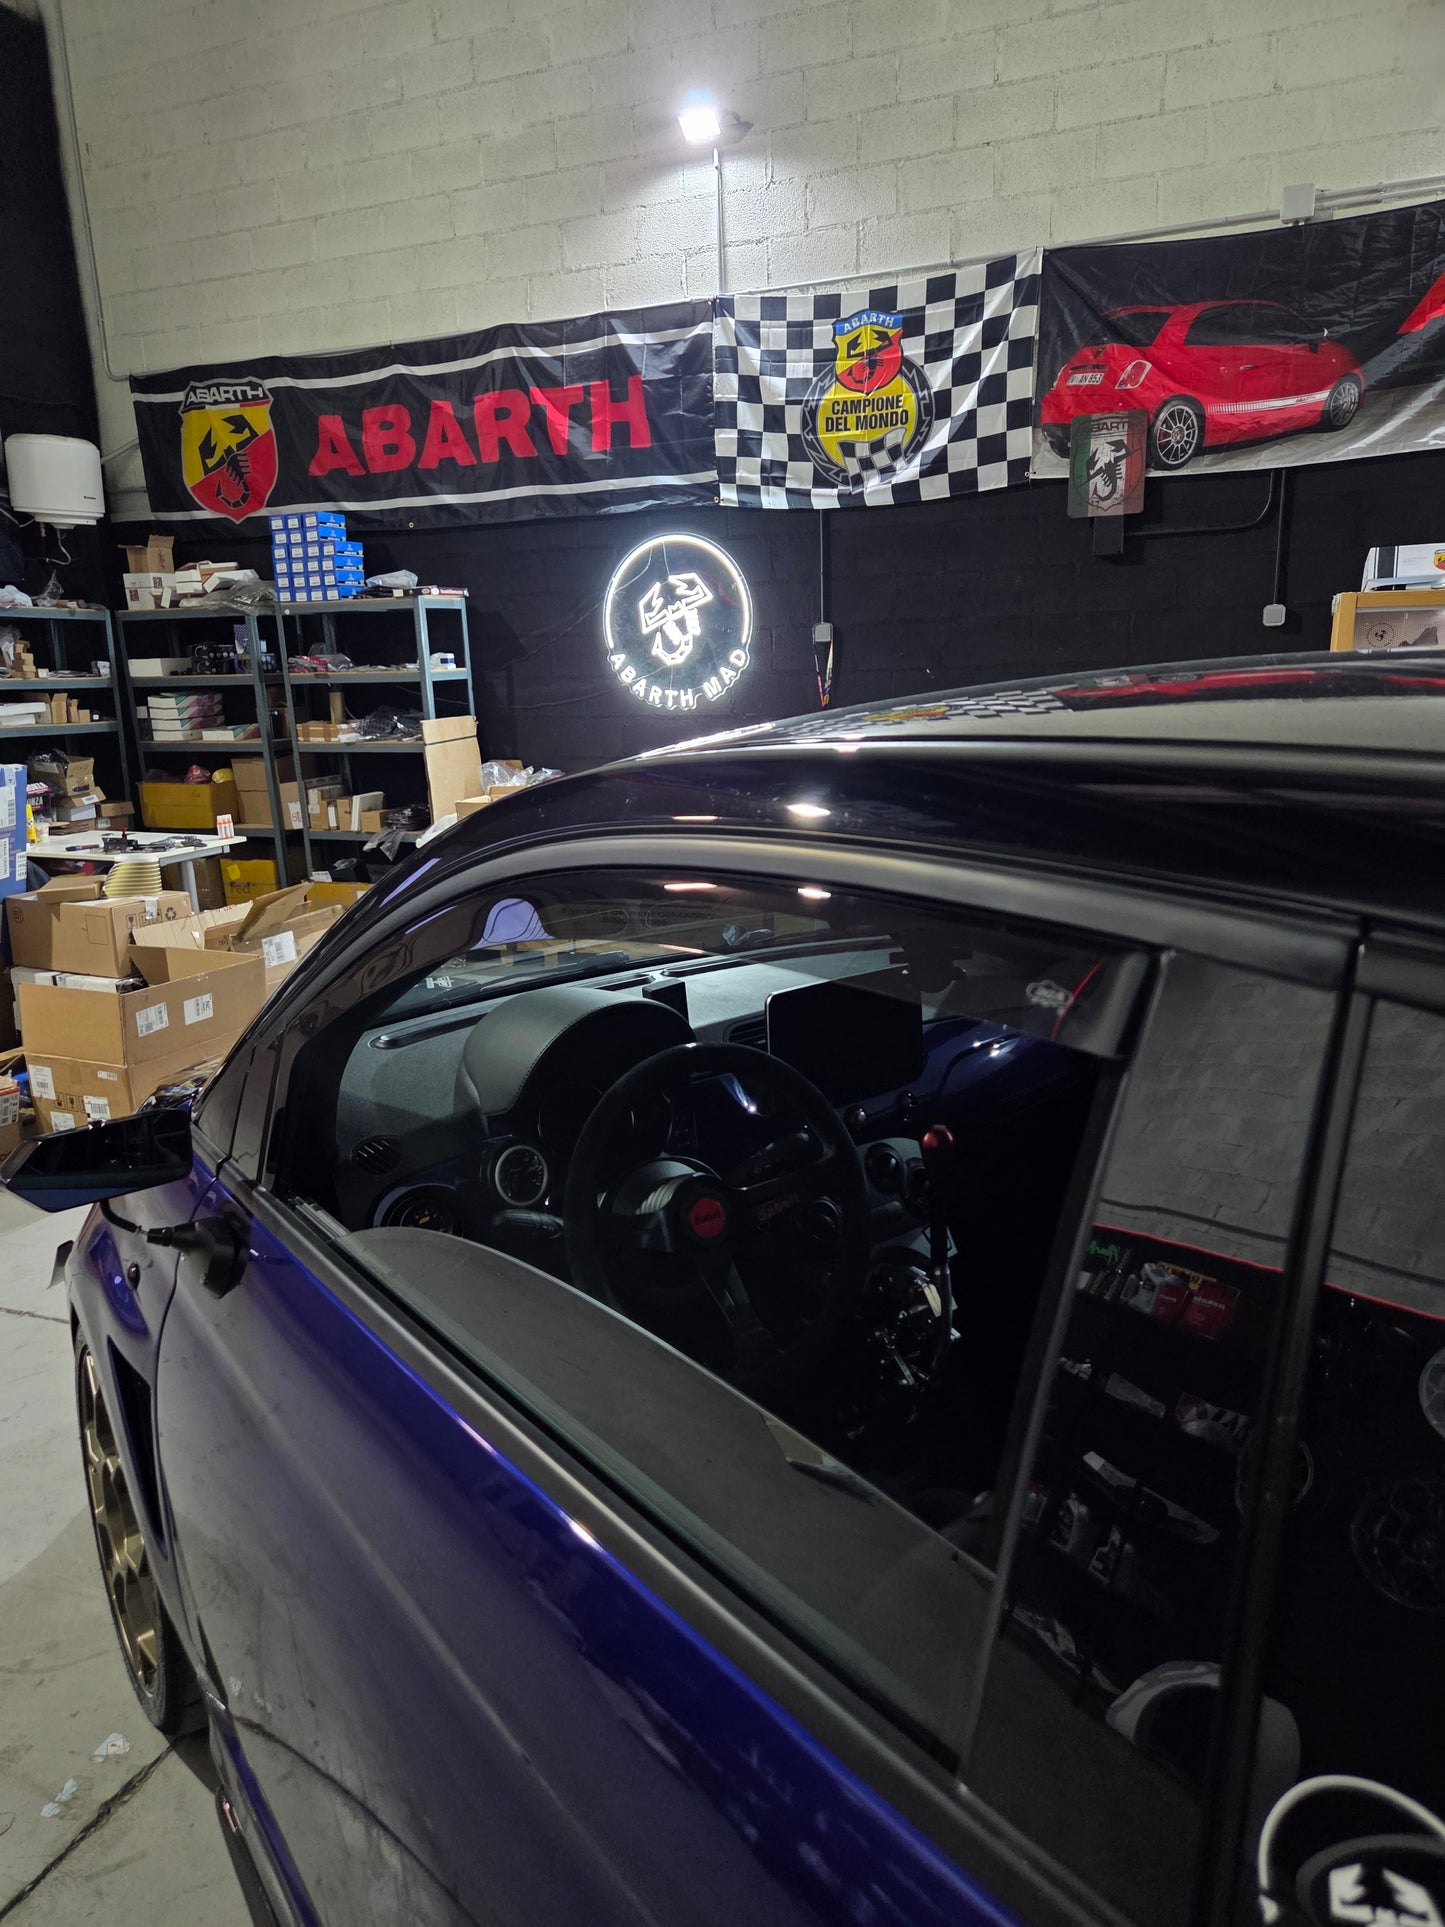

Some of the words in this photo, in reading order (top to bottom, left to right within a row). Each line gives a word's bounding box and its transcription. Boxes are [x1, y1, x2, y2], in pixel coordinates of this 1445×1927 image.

[843, 313, 895, 333] ABARTH
[186, 385, 264, 406] ABARTH
[831, 394, 904, 416] CAMPIONE
[308, 375, 652, 477] ABARTH
[825, 416, 851, 433] DEL
[855, 410, 909, 432] MONDO
[611, 652, 695, 708] ABARTH
[703, 649, 747, 699] MAD
